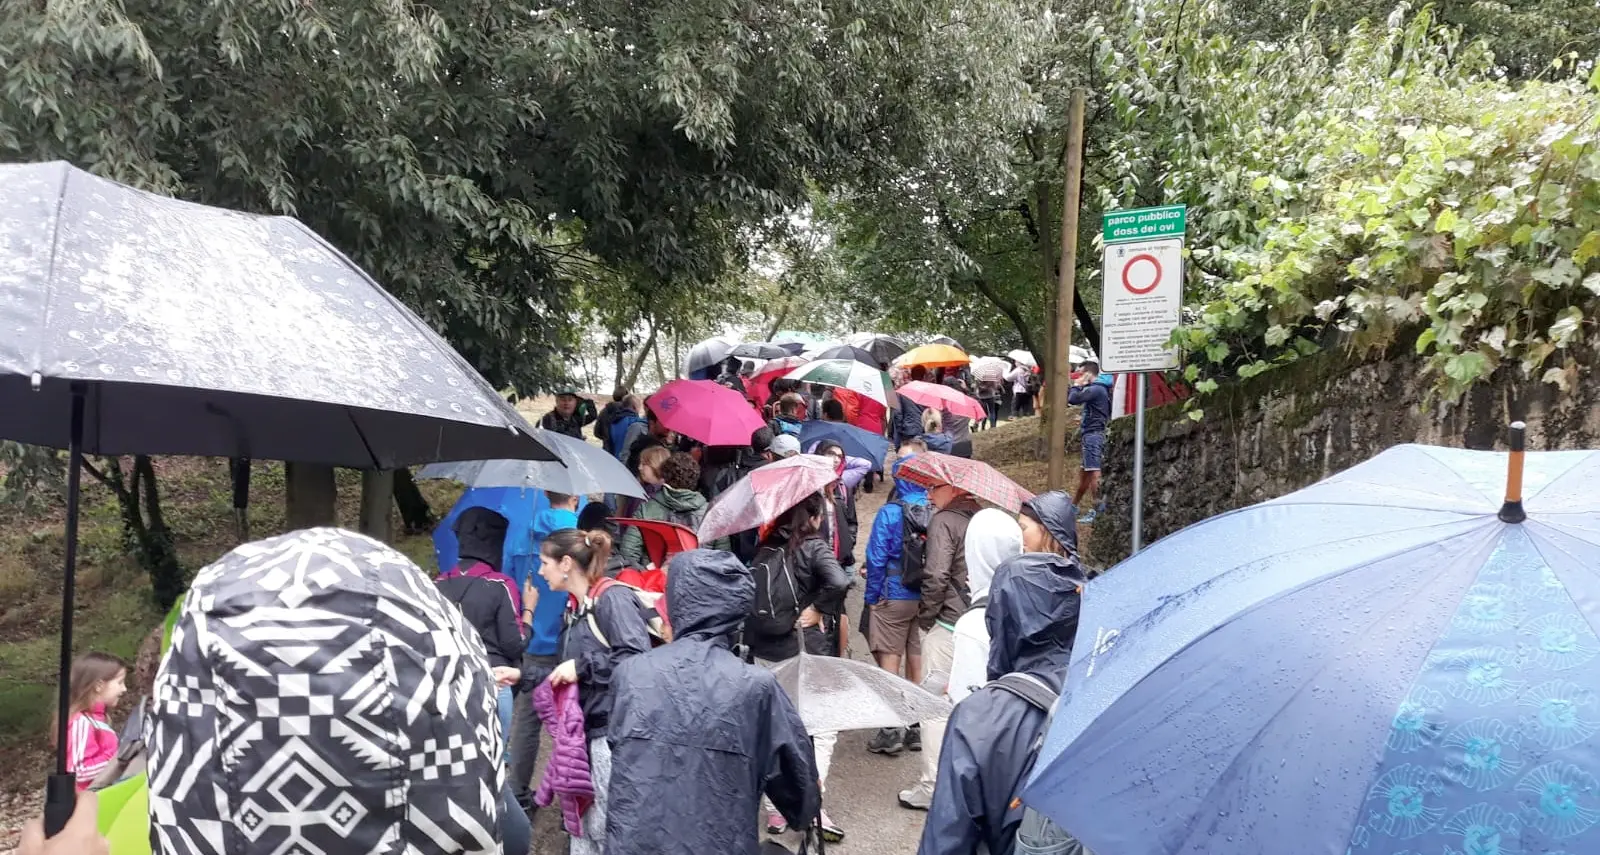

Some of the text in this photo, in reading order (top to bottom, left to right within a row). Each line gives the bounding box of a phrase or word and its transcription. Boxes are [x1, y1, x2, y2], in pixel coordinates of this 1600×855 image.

[1108, 210, 1181, 227] parco pubblico
[1113, 222, 1175, 236] doss dei ovi
